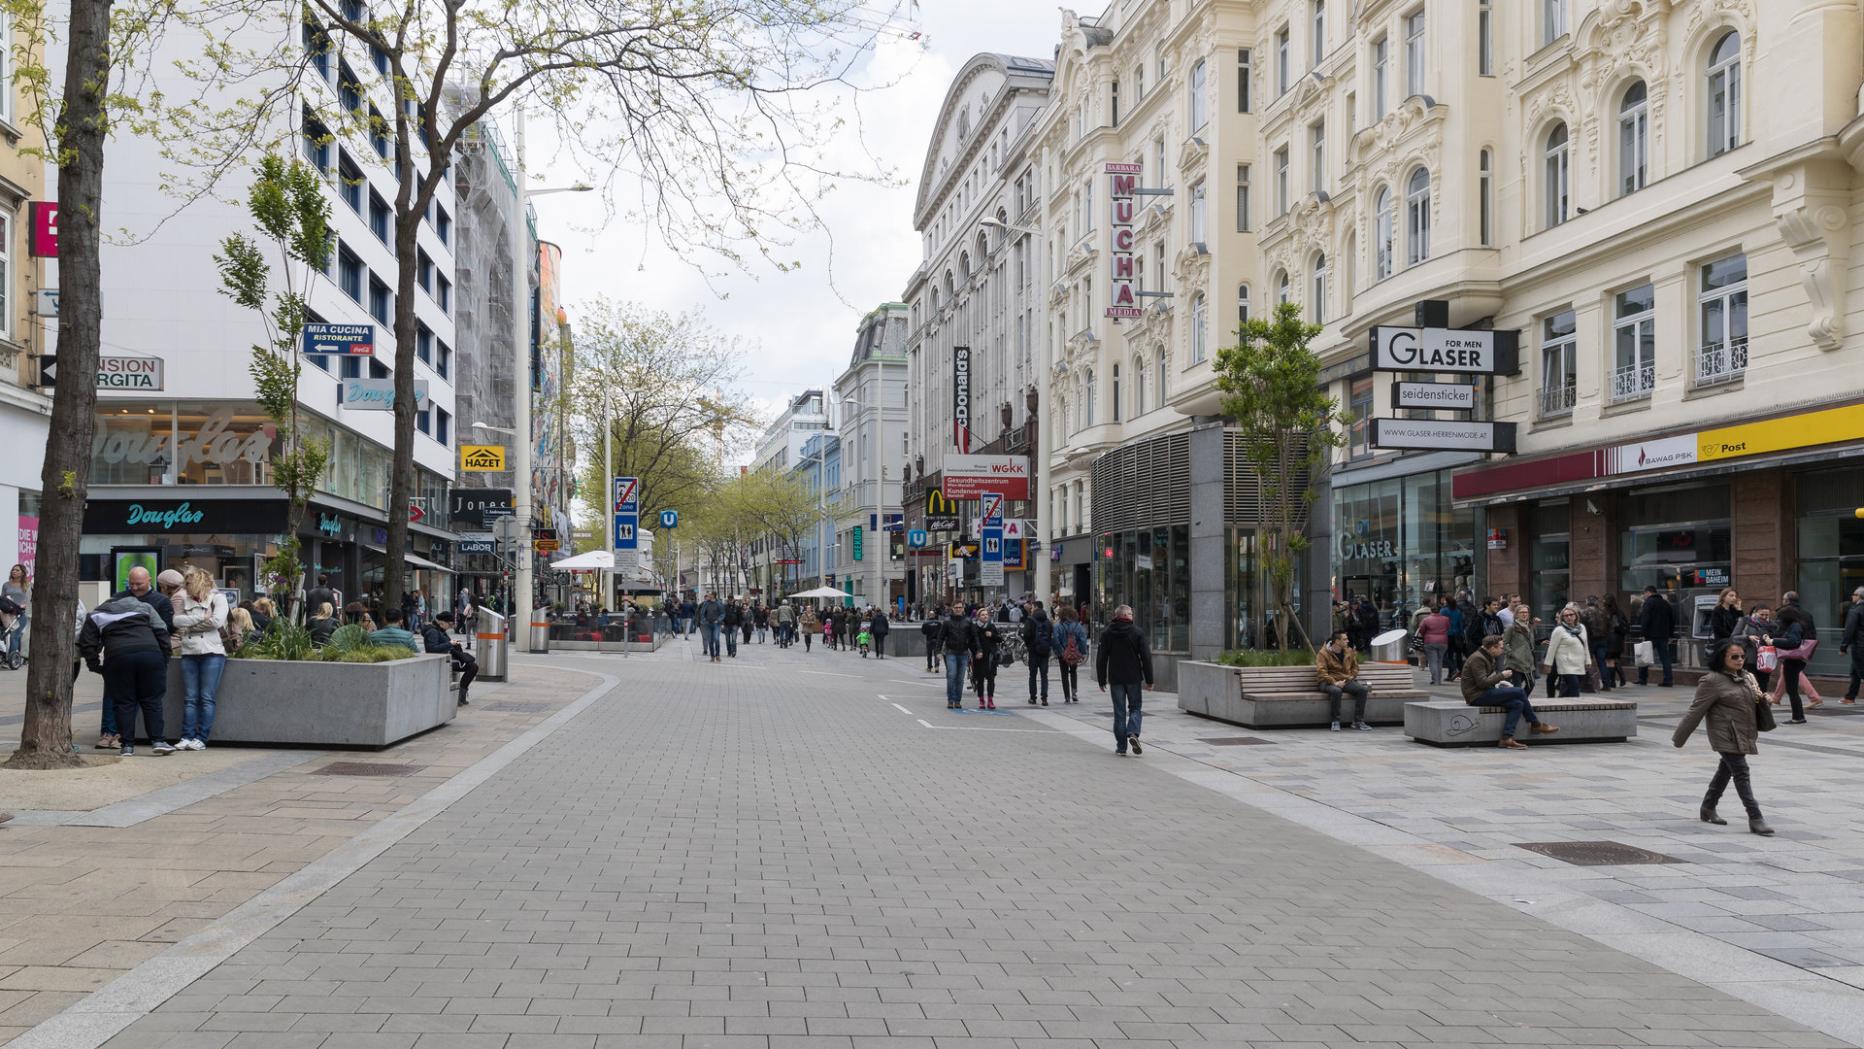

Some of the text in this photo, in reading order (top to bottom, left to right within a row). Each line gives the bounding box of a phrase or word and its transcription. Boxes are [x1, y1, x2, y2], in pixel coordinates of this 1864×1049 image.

[1106, 163, 1142, 172] BARBARA
[1113, 175, 1136, 304] MUCHA
[1107, 308, 1141, 317] MEDIA
[307, 325, 369, 335] MIA CUCINA
[1389, 332, 1482, 367] GLASER
[96, 359, 155, 373] NSION
[96, 373, 153, 387] RGITA
[956, 349, 968, 428] cDonald's
[1402, 387, 1470, 401] seidensticker
[1383, 429, 1488, 439] WWW.GLASER-HERRENMODE.AT
[1721, 442, 1747, 454] Post
[465, 458, 501, 468] HAZET
[1645, 454, 1674, 465] BAWAG
[454, 497, 506, 513] Jones
[127, 502, 204, 529] Douglas
[663, 513, 675, 526] U
[912, 533, 924, 544] U
[461, 543, 491, 551] LABOR
[1338, 532, 1392, 560] GLASER
[1705, 568, 1722, 576] MEIN
